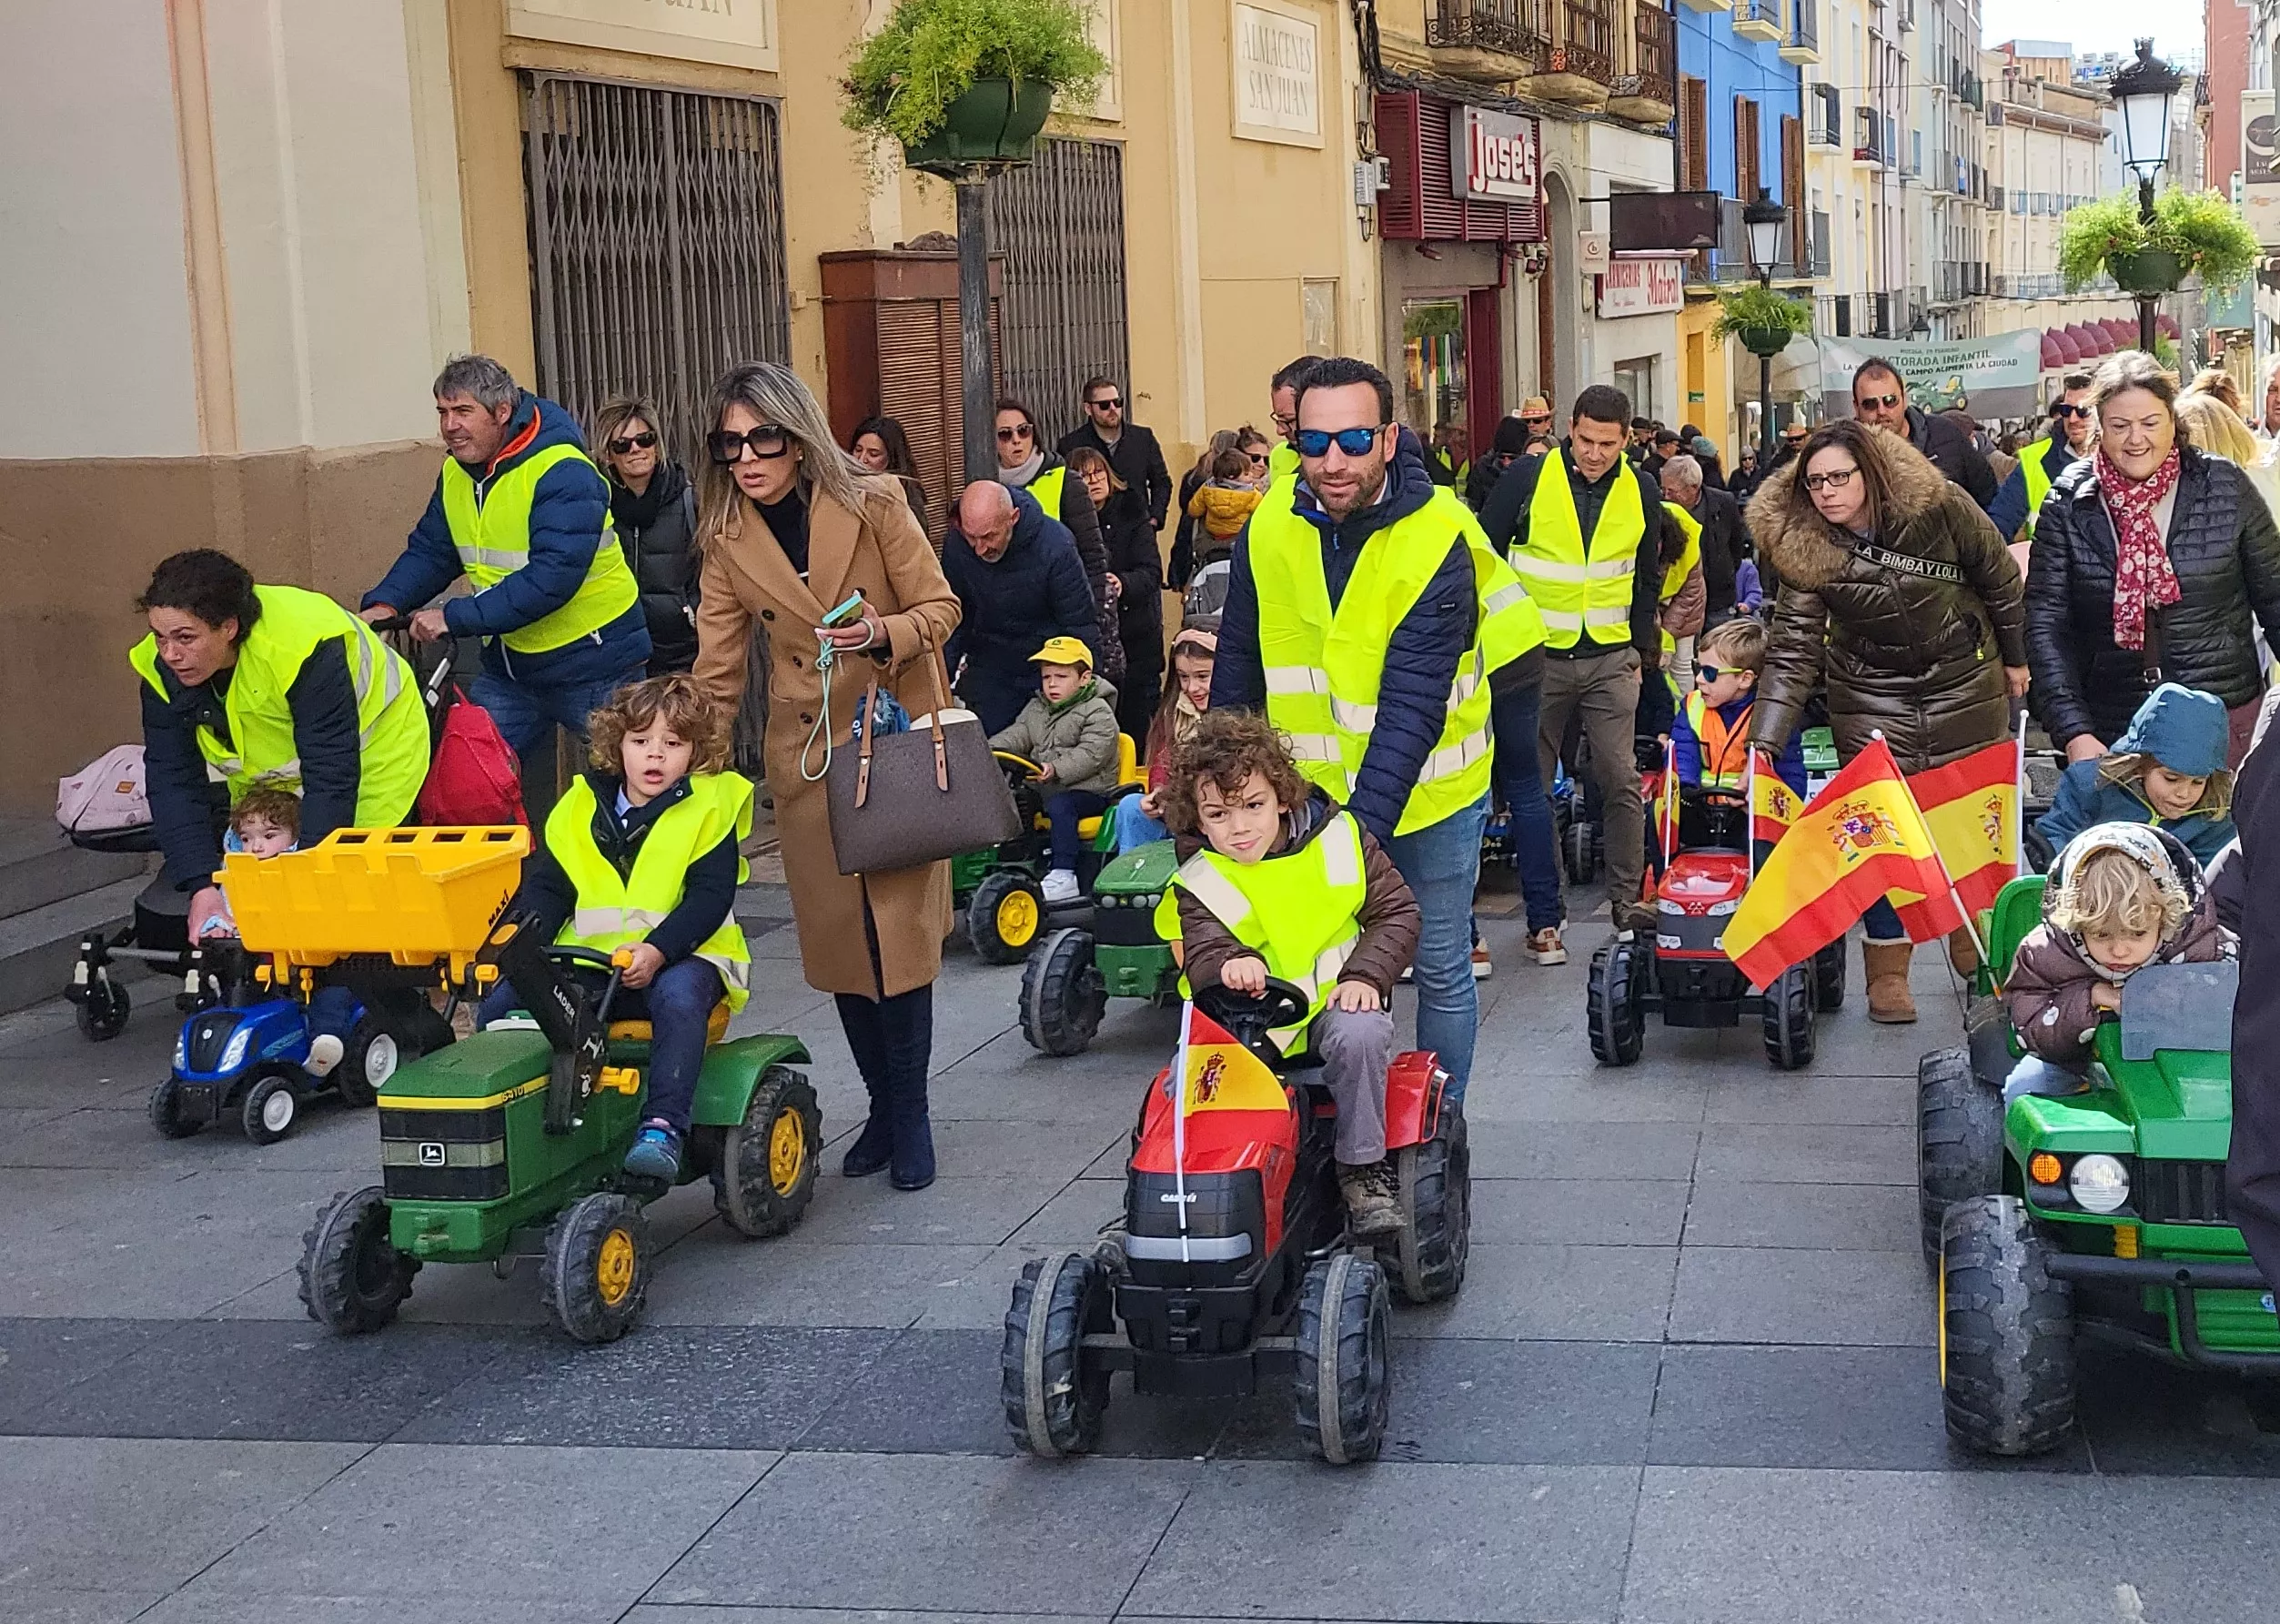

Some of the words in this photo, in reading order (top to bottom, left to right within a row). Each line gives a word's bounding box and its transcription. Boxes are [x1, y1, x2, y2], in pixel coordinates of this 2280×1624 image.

[1243, 22, 1311, 75] ALMACENES
[1249, 70, 1273, 111] SAN
[1277, 76, 1307, 116] JUAN
[1905, 368, 1933, 376] CAMPO
[1935, 364, 1974, 374] ALIMENTA
[1976, 361, 1985, 369] LA
[1988, 358, 2018, 368] CIUDAD
[1943, 349, 1991, 364] INFANTIL
[553, 984, 575, 1018] LADER
